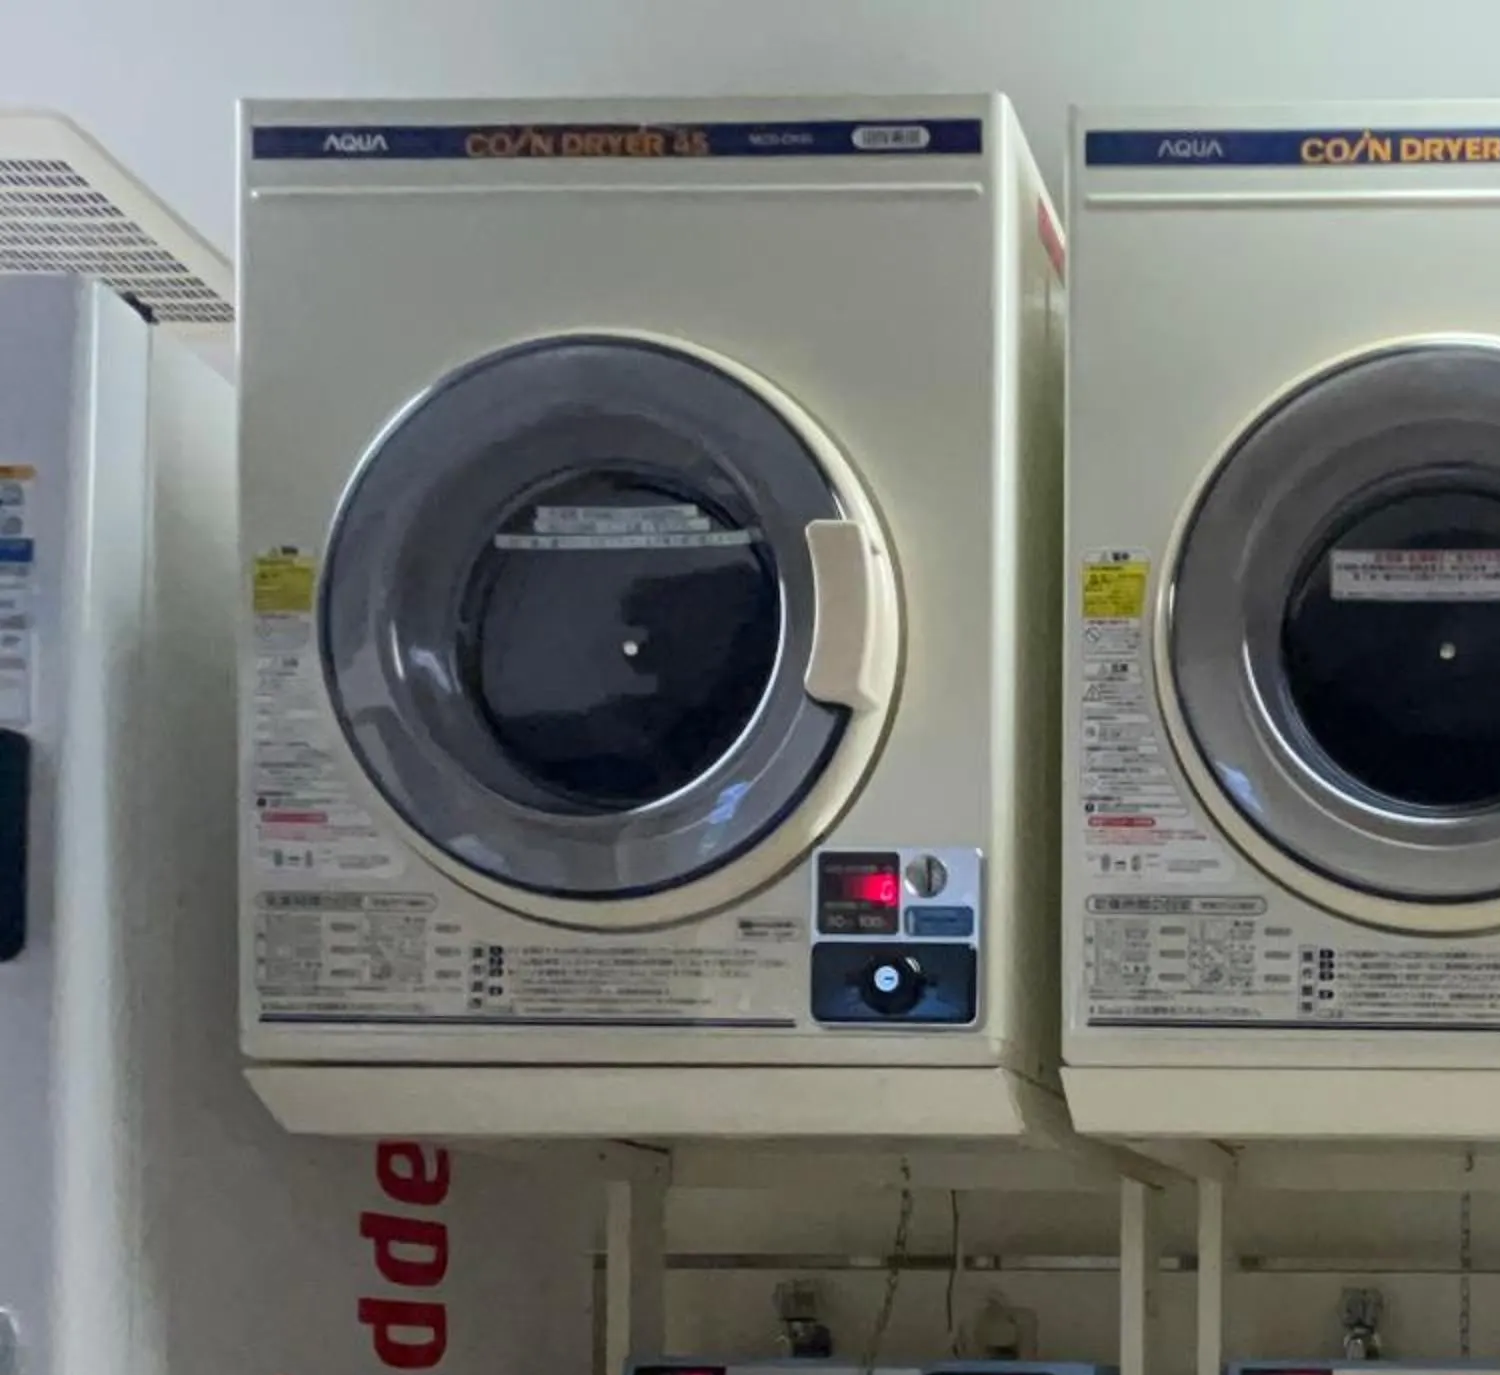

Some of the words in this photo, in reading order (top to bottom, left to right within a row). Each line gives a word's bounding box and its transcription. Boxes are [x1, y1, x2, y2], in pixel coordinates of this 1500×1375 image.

[323, 133, 389, 150] AQUA
[561, 132, 663, 157] DRYER
[1158, 139, 1223, 157] AQUA
